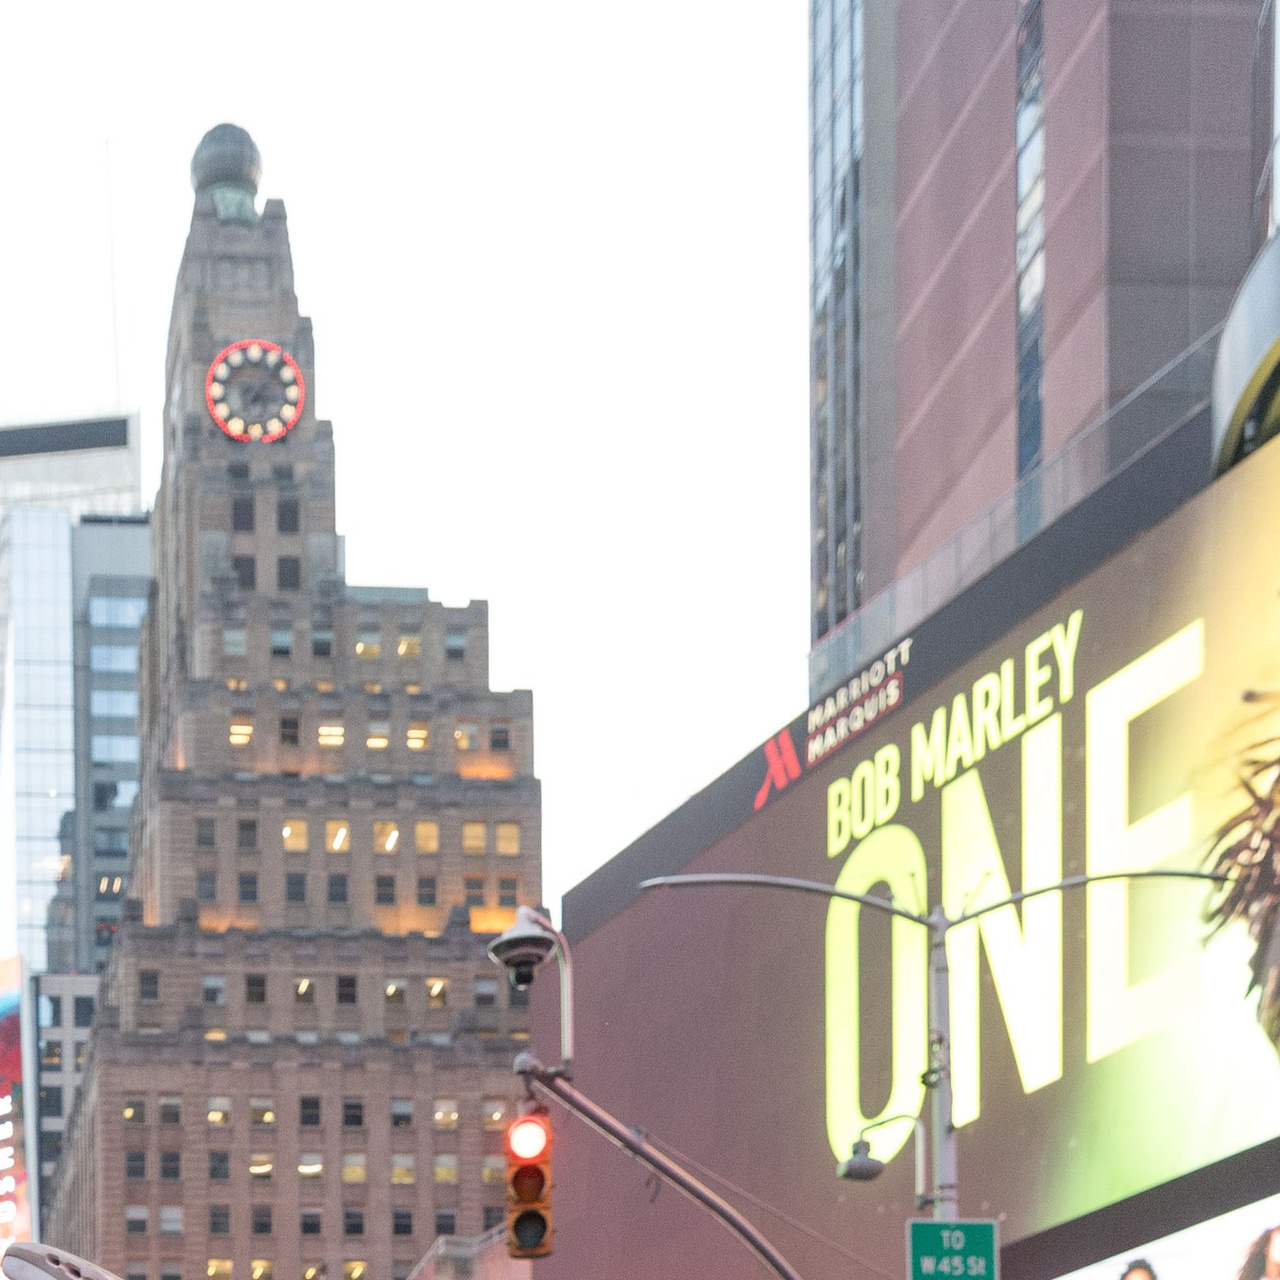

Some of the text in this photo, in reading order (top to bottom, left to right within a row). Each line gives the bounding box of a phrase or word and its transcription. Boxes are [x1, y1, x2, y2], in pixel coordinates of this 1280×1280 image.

[808, 637, 913, 733] MARRIOTT
[808, 678, 901, 763] MARQUIS
[827, 609, 1084, 858] BOB MARLEY
[825, 616, 1204, 1170] ONE
[920, 1256, 986, 1275] W 45 St
[941, 1231, 965, 1251] TO
